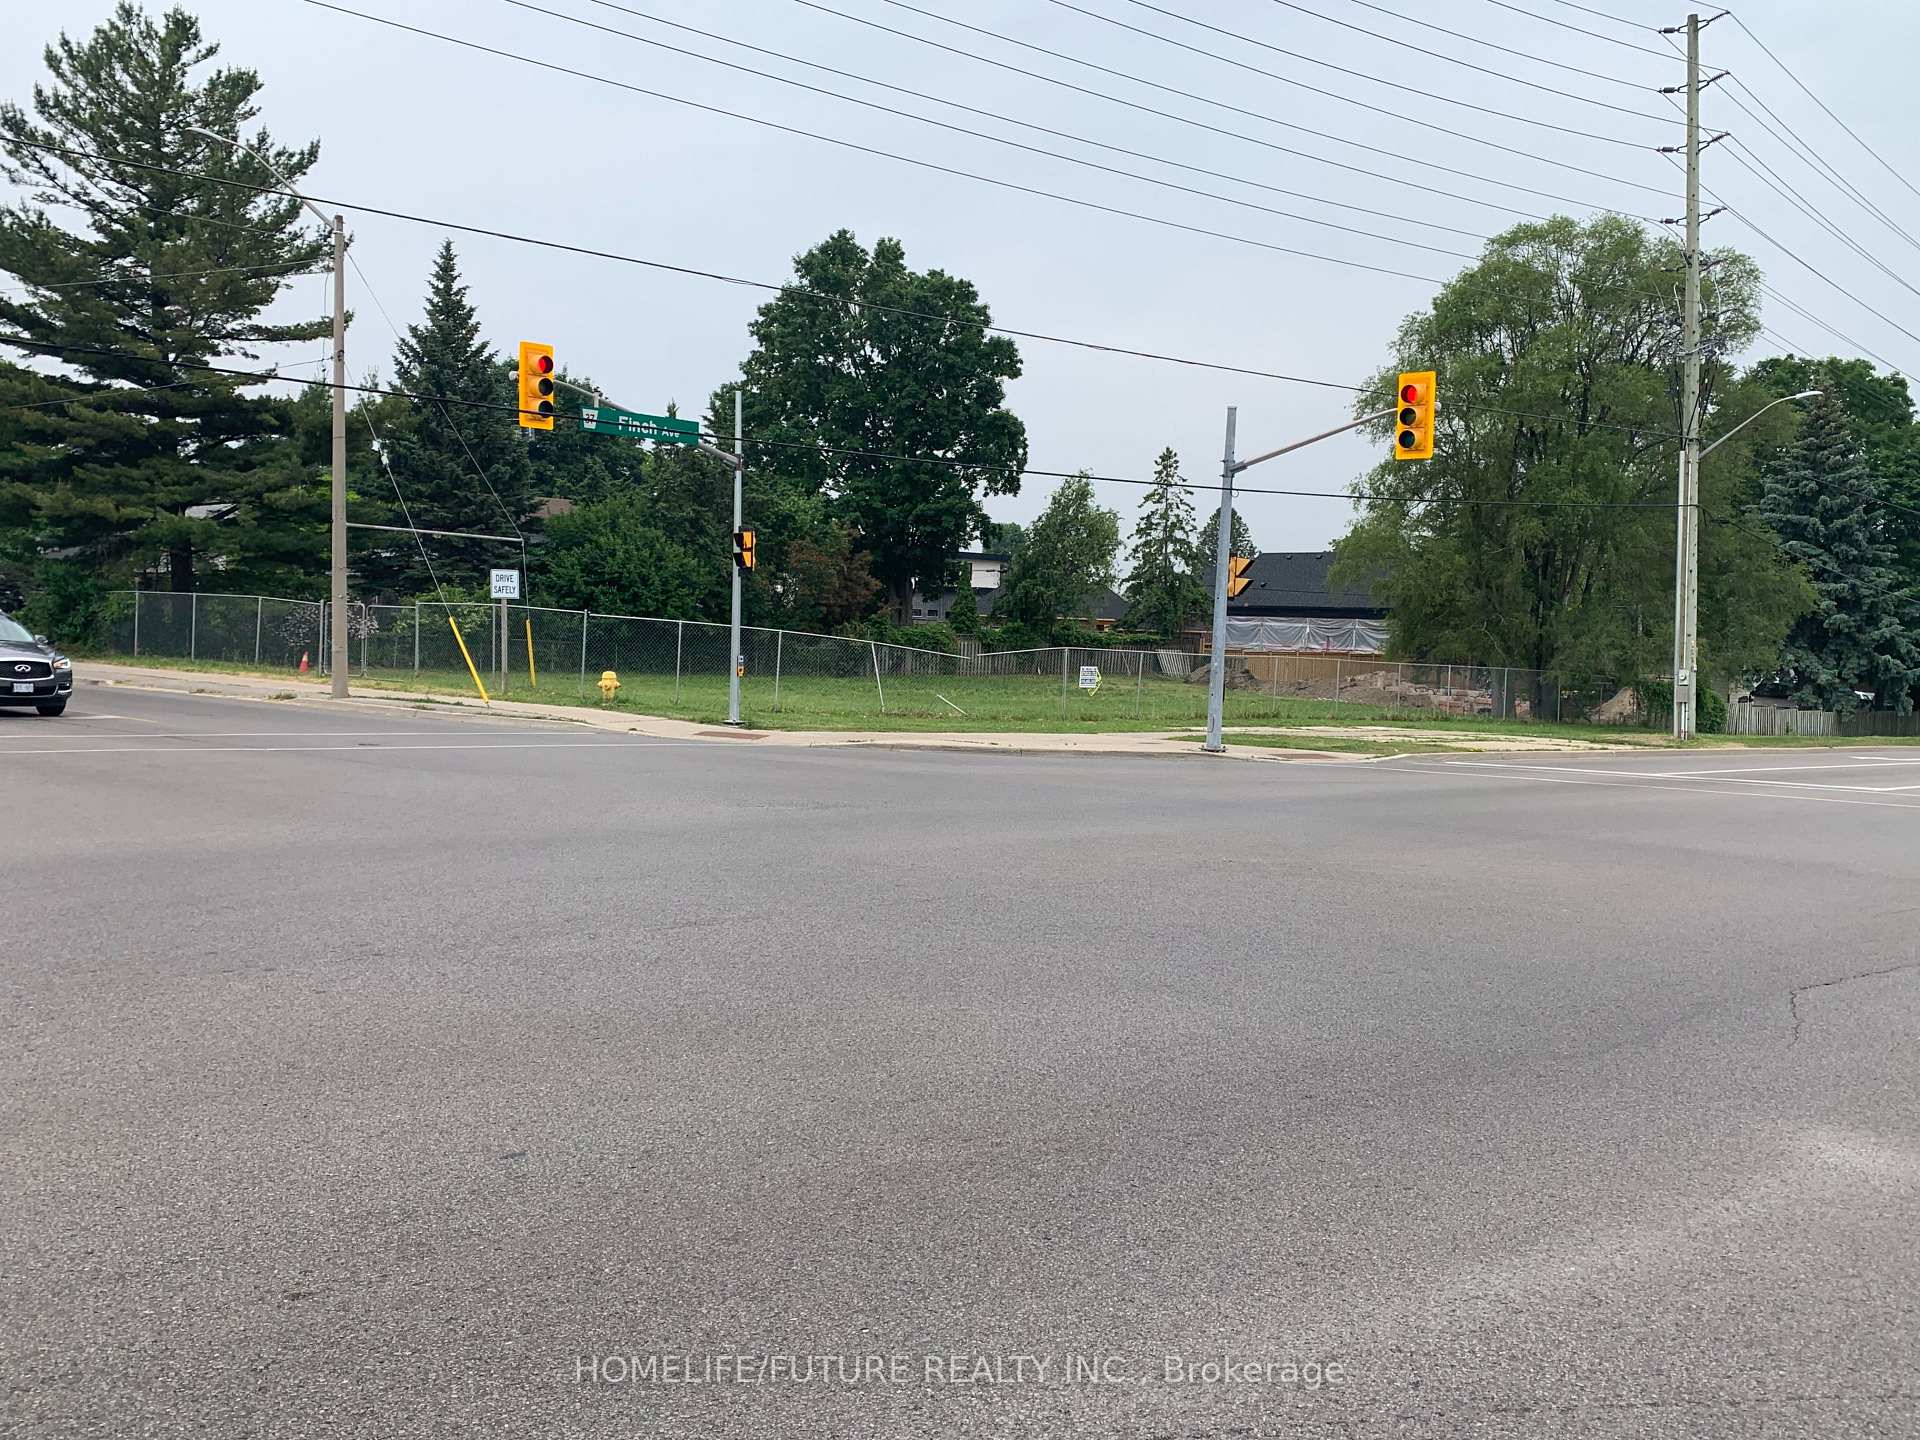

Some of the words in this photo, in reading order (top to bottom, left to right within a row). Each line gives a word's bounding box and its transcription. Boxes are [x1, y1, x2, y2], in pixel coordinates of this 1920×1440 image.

[618, 415, 658, 435] Finch
[495, 574, 515, 583] DRIVE
[493, 585, 517, 594] SAFELY
